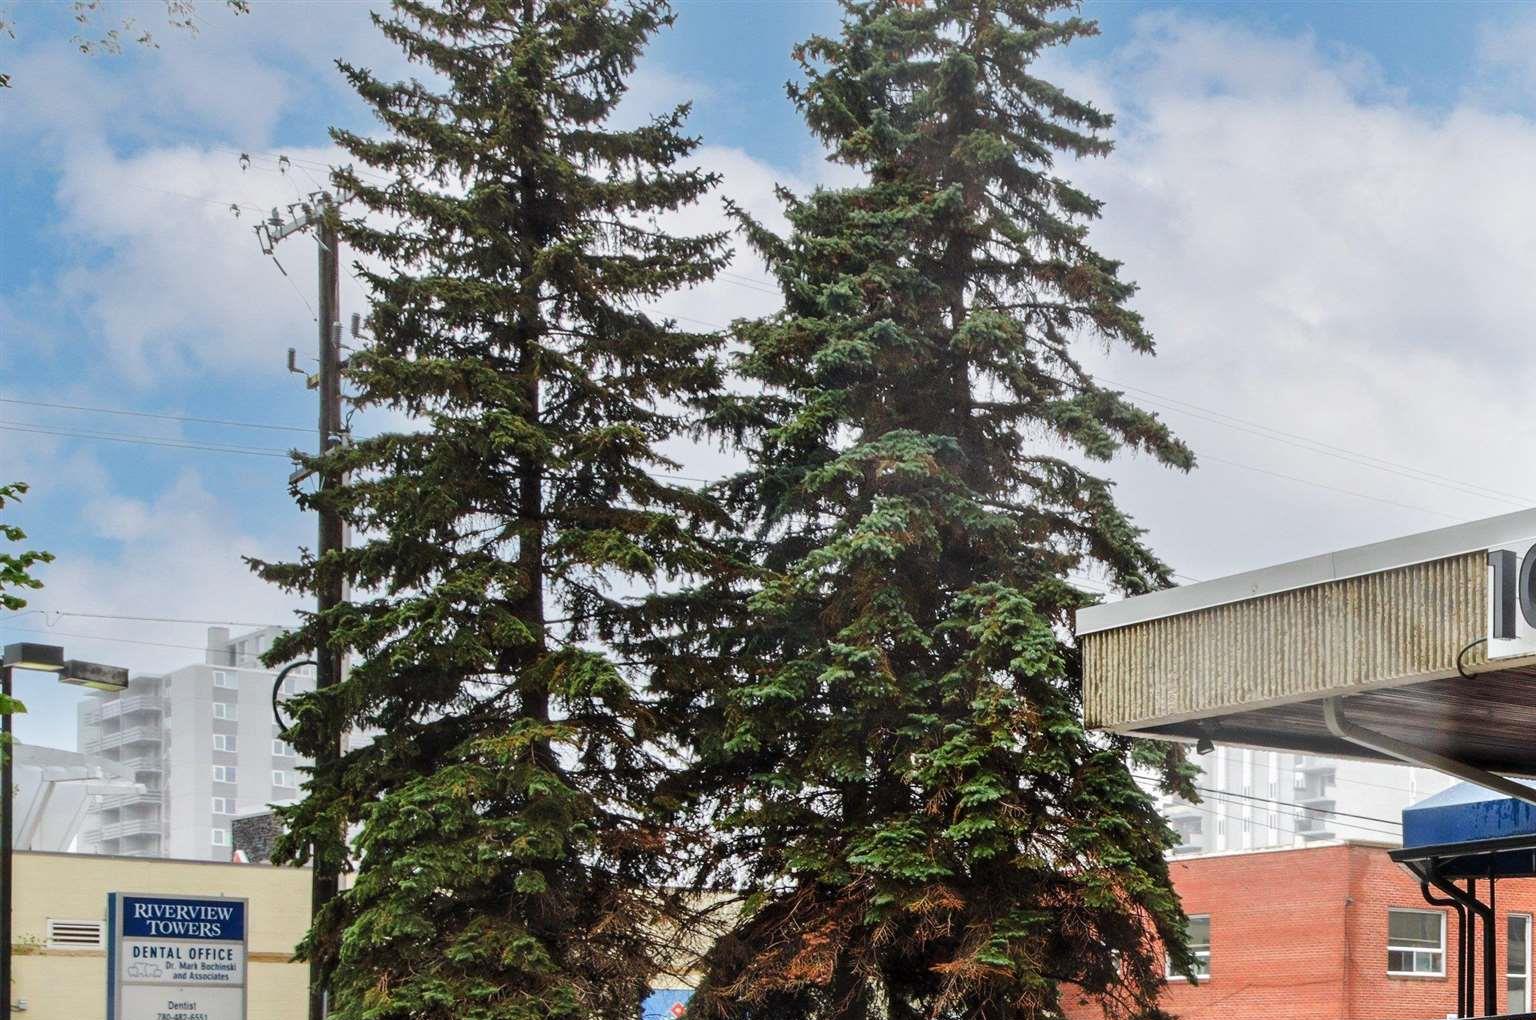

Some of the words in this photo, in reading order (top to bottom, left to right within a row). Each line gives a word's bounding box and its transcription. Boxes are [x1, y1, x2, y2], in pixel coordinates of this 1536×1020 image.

[134, 902, 233, 921] RIVERVIEW
[146, 920, 221, 937] TOWERS
[133, 946, 182, 959] DENTAL
[189, 947, 233, 961] OFFICE
[165, 961, 176, 970] Dr.
[179, 961, 198, 971] Mark
[173, 971, 187, 980] and
[190, 971, 230, 981] Associates
[168, 1001, 197, 1010] Dentist
